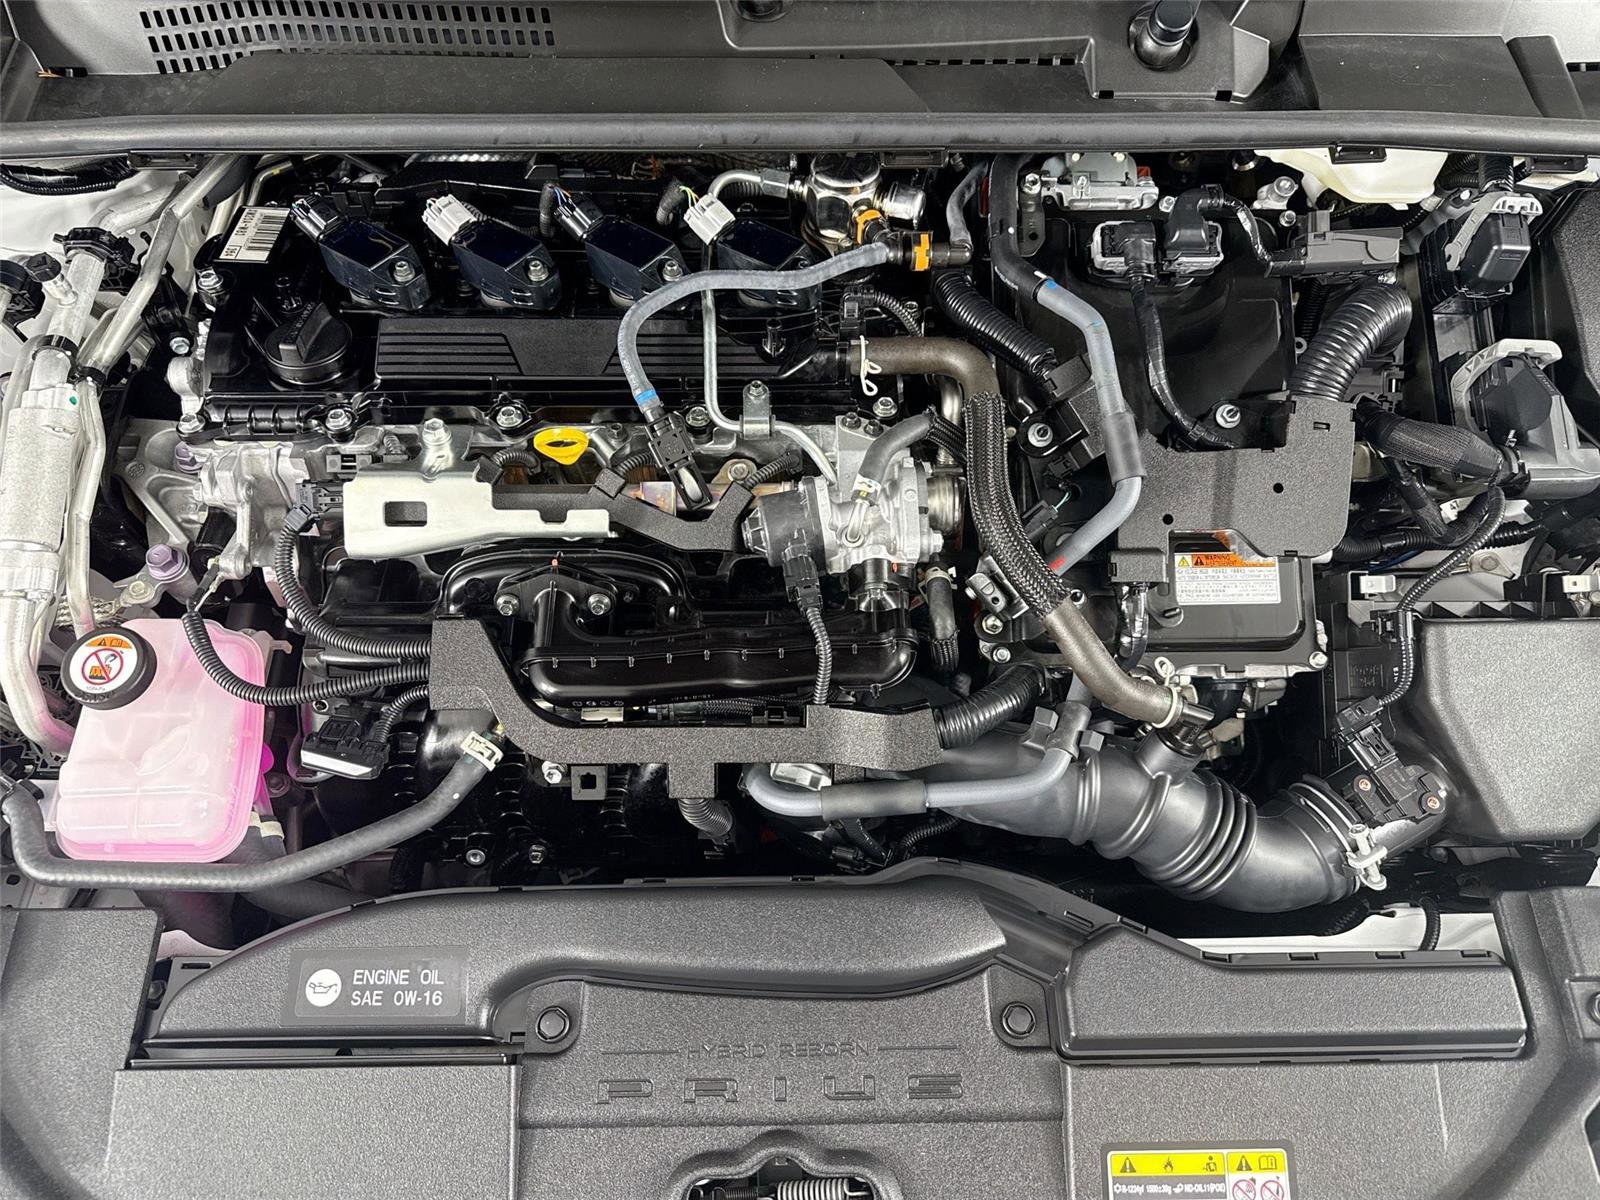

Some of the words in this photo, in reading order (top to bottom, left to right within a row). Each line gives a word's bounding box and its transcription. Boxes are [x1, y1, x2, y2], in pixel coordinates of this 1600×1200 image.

[353, 969, 410, 985] ENGINE
[420, 969, 444, 985] OIL
[351, 990, 383, 1006] SAE
[393, 990, 443, 1006] 0W-16
[687, 1042, 768, 1059] HYBRID
[779, 1041, 869, 1058] REBORN
[596, 1074, 964, 1104] PRIUS
